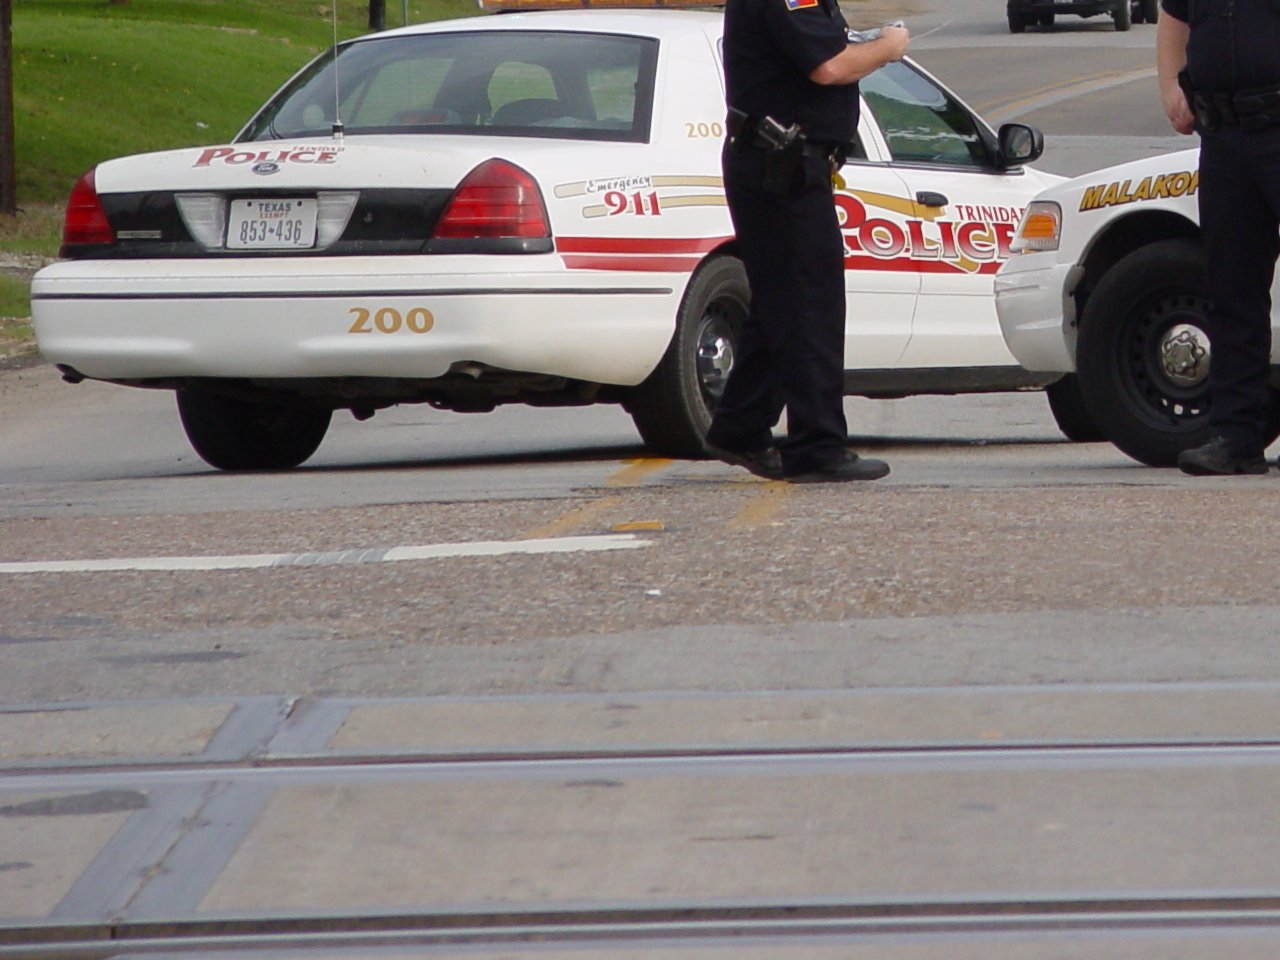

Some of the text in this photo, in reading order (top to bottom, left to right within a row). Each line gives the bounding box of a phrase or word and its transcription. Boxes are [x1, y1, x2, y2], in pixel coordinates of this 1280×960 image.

[685, 122, 723, 138] 200
[192, 147, 338, 168] POLICE
[587, 175, 651, 193] Emergency
[258, 203, 291, 212] TEXAS
[604, 191, 662, 216] 911
[348, 307, 434, 334] 200
